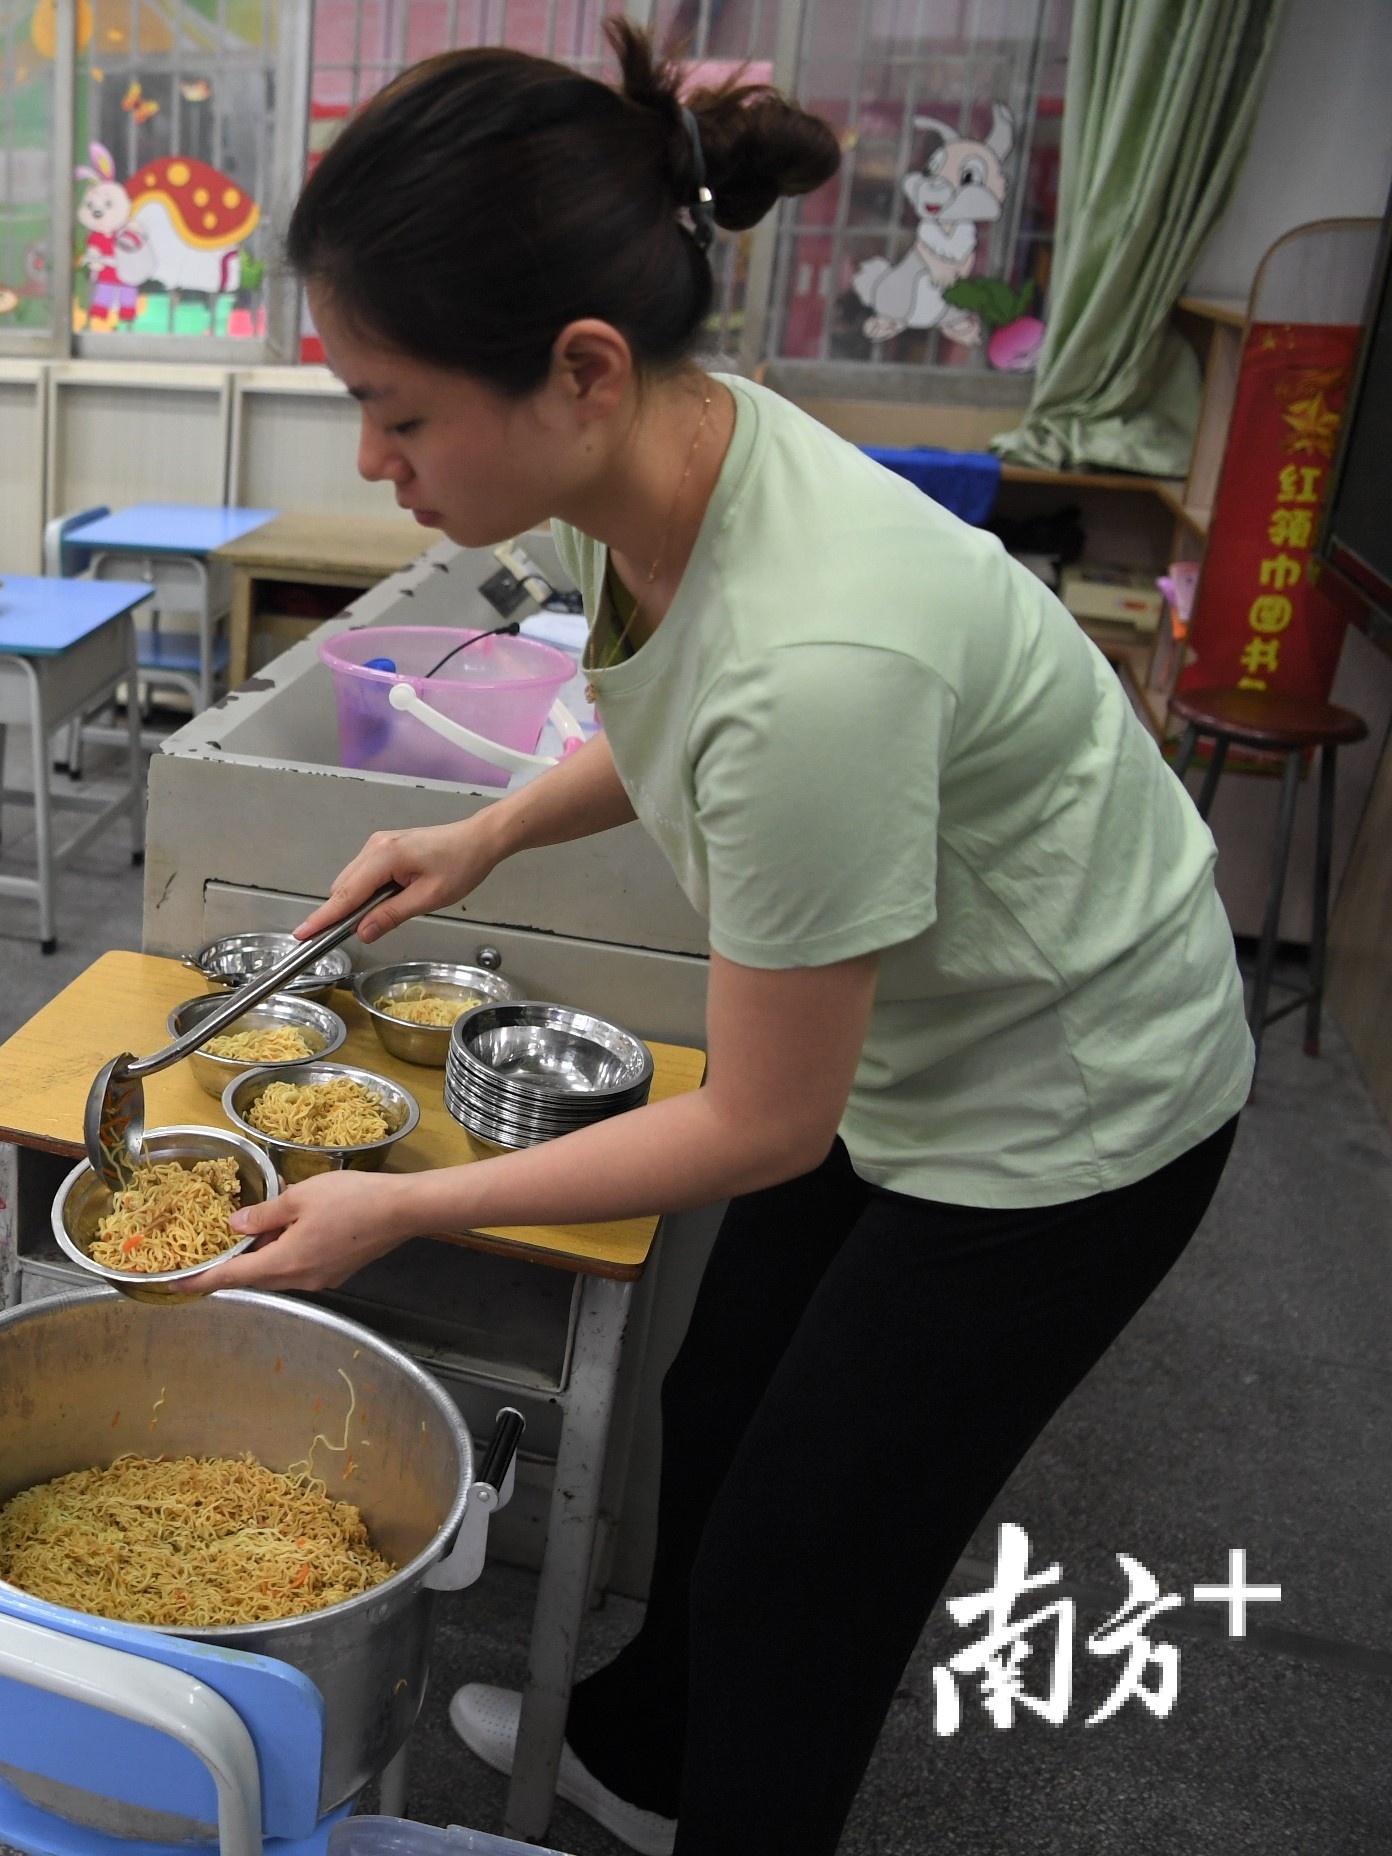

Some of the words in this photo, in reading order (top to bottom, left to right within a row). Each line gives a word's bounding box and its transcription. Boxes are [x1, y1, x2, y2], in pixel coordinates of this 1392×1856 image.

[1237, 463, 1322, 691] 红领巾图书
